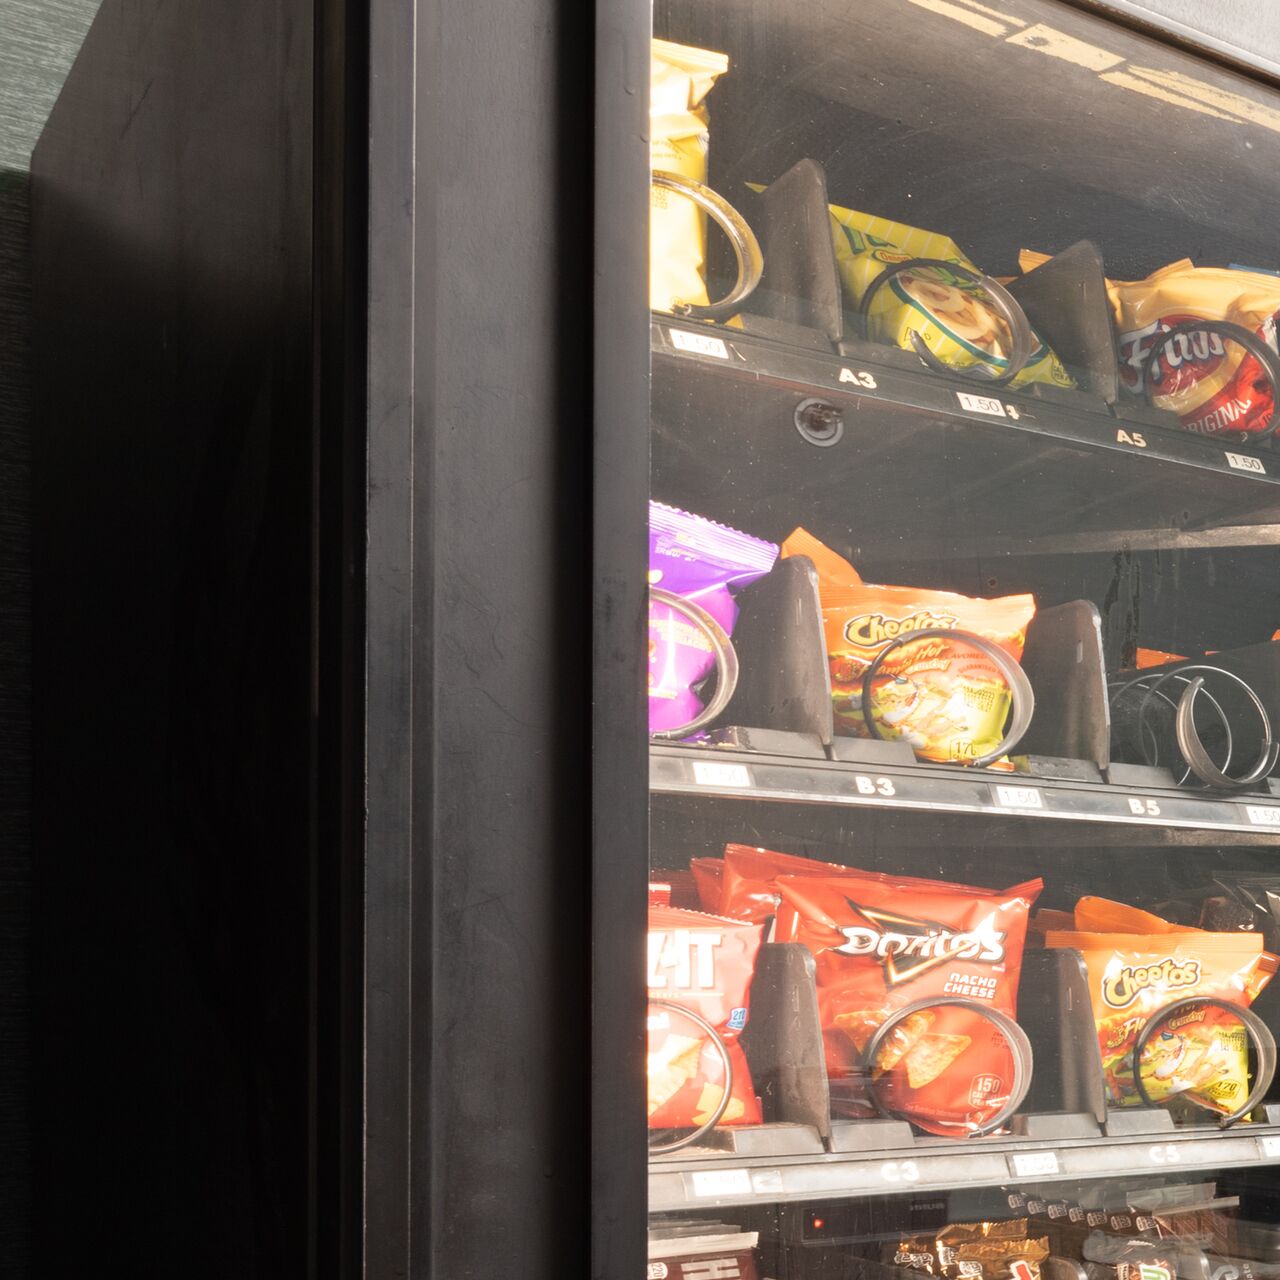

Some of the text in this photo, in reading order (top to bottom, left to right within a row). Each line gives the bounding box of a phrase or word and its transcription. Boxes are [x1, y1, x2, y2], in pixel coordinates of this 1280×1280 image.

[839, 368, 877, 389] A3
[965, 395, 999, 413] 1.50
[1116, 429, 1147, 448] A5
[1230, 455, 1261, 471] 1.50
[856, 777, 896, 796] B3
[1003, 791, 1039, 805] 1.50
[1128, 799, 1161, 815] B5
[837, 925, 1006, 965] Doritos
[949, 973, 998, 988] NACHO
[1103, 959, 1199, 1006] Cheetos
[943, 982, 997, 999] CHEESE
[977, 1077, 1000, 1094] 150
[1149, 1146, 1180, 1163] C5
[881, 1162, 919, 1182] C3
